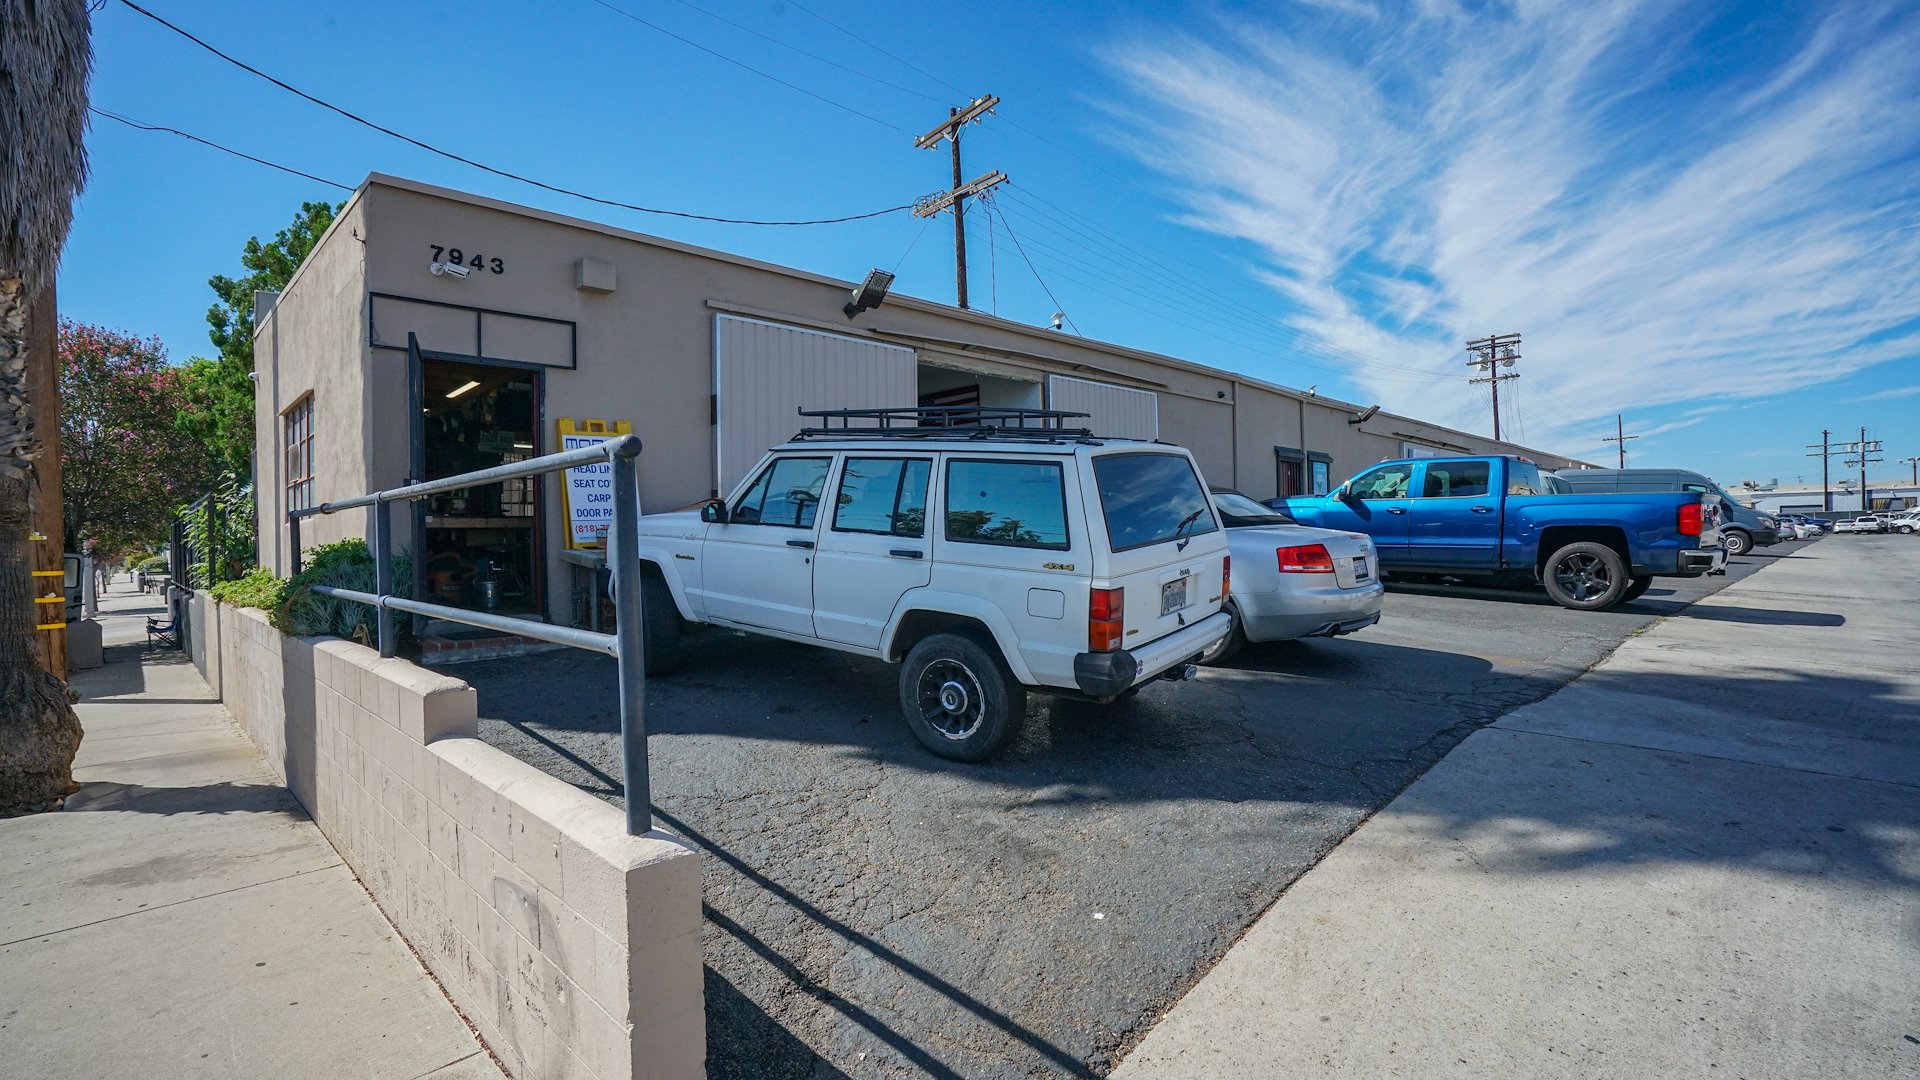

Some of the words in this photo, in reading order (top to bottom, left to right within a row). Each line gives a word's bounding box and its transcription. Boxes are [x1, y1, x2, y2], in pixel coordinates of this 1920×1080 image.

[430, 244, 504, 274] 7943
[573, 464, 597, 474] HEAD
[573, 479, 596, 488] SEAT
[597, 479, 612, 488] CO
[576, 508, 601, 518] DOOR
